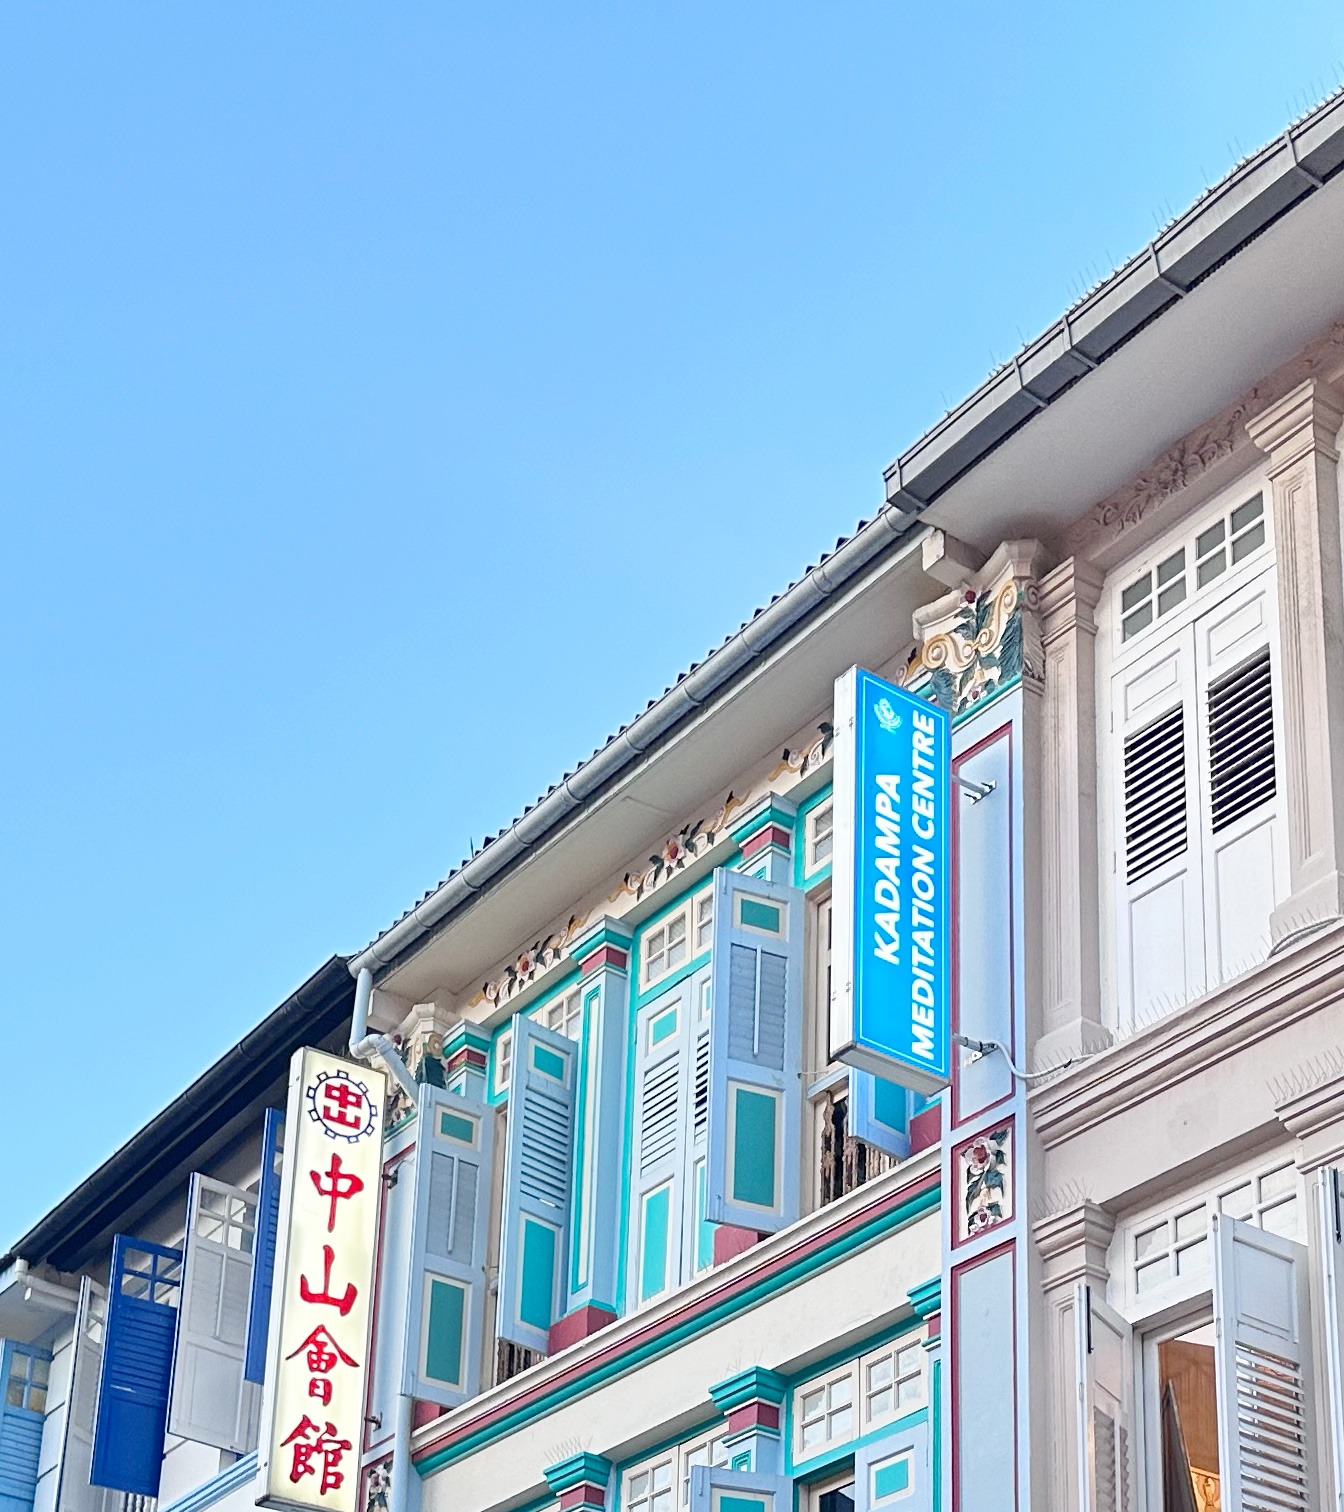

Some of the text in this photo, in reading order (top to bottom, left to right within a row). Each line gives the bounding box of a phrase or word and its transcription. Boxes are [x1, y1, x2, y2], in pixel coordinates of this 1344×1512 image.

[874, 773, 901, 965] KADAMPA
[911, 709, 936, 1060] MEDITATION CENTRE
[280, 1152, 365, 1496] 中山會館
